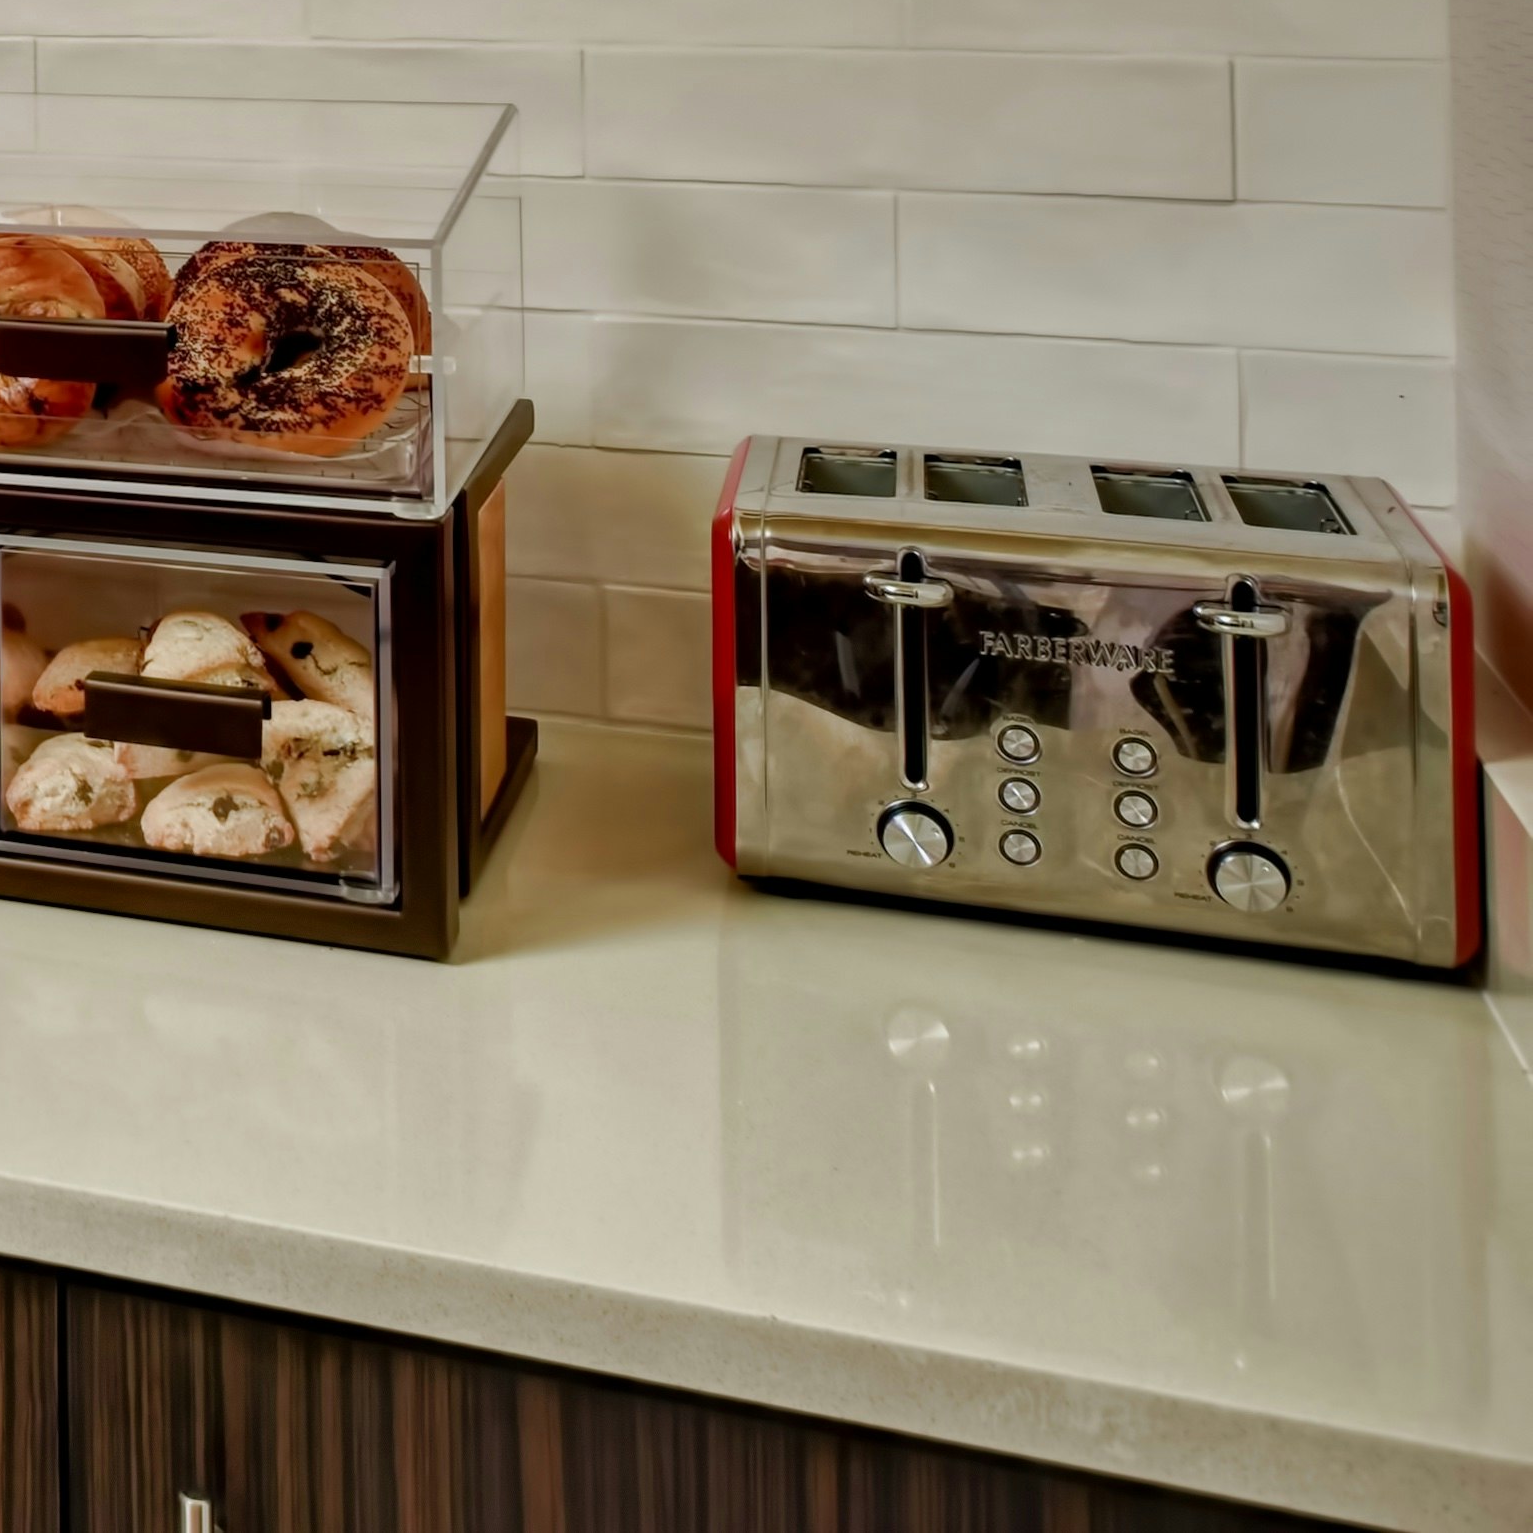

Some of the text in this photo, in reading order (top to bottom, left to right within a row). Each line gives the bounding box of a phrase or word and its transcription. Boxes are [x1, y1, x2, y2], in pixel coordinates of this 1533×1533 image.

[979, 630, 1175, 675] FARBERWARE
[996, 767, 1042, 778] DEFROST
[1112, 780, 1159, 791] DEFROST
[1000, 818, 1038, 830] CANCEL
[1117, 833, 1156, 845] CANCEL
